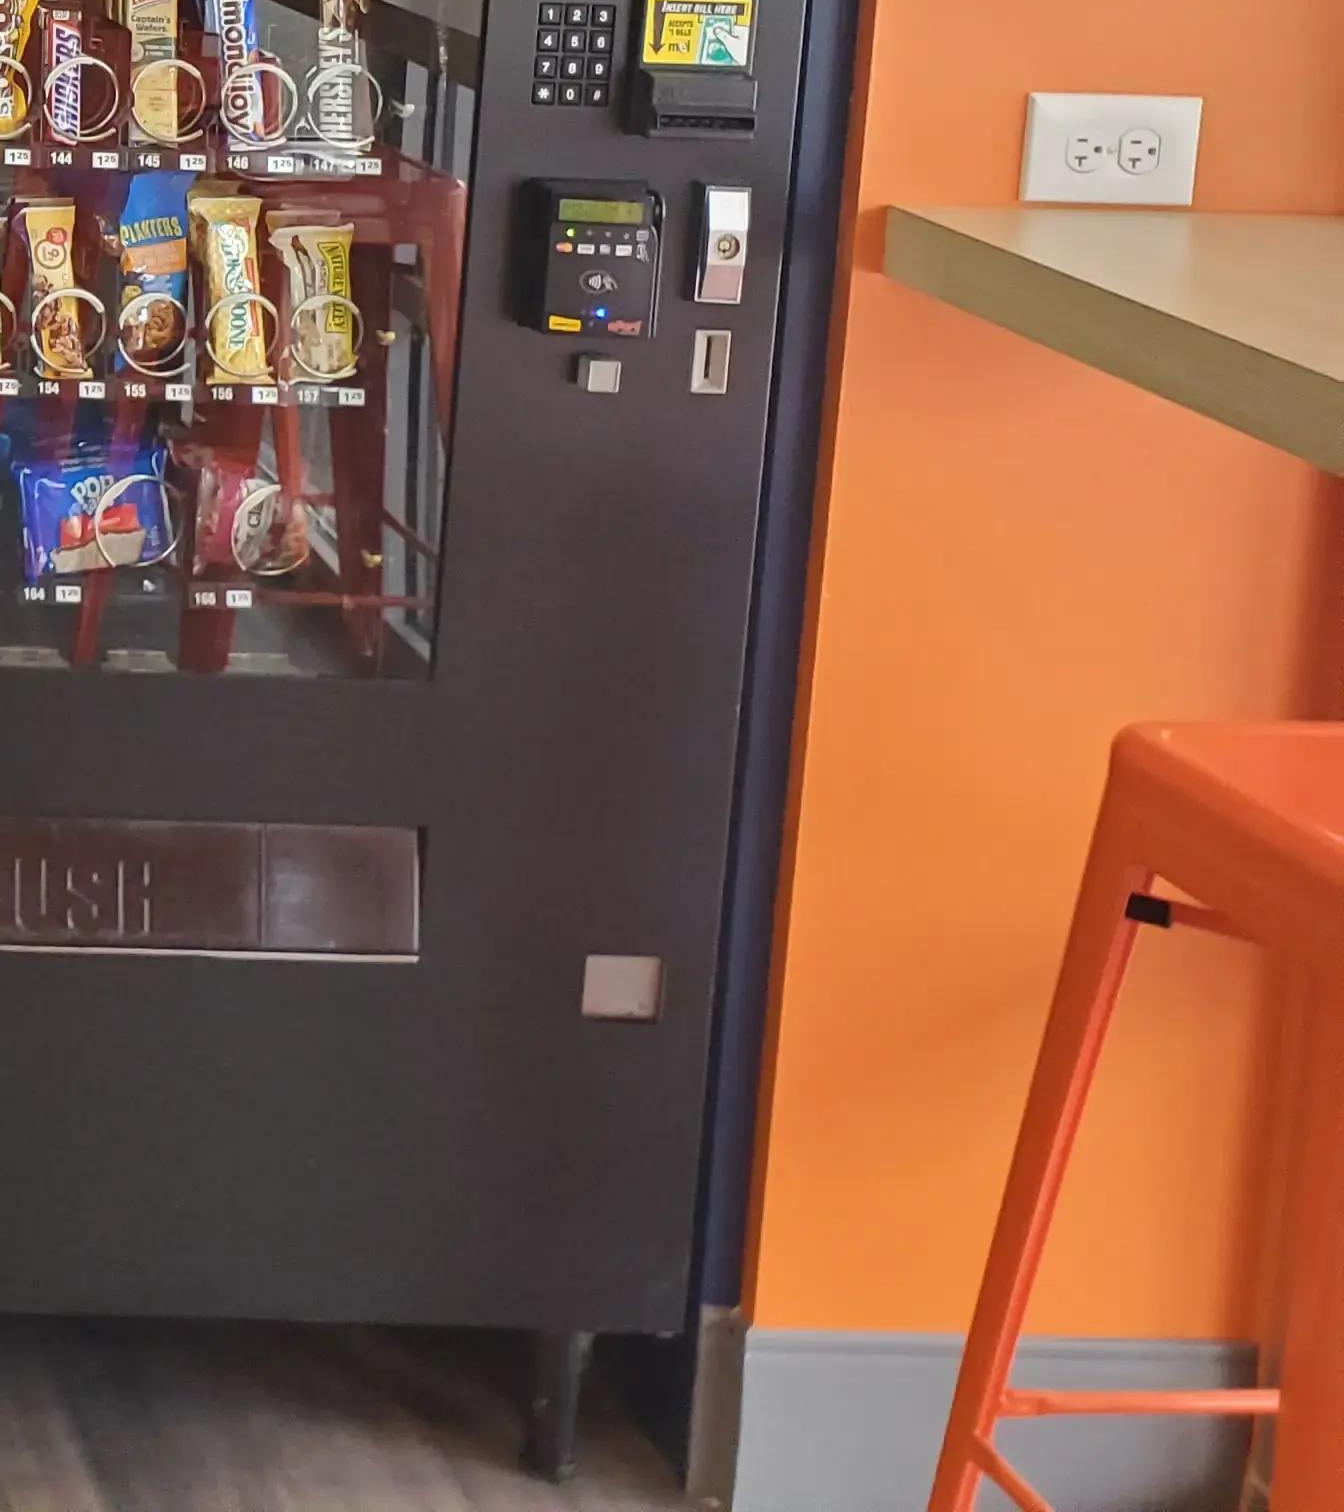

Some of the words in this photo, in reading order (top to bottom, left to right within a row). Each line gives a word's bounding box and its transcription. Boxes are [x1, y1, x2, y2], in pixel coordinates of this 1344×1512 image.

[661, 1, 692, 14] INSERT
[694, 3, 712, 14] BILL
[130, 14, 170, 26] Captain's
[547, 8, 553, 21] 1
[572, 9, 581, 21] 2
[599, 10, 608, 21] 3
[544, 35, 552, 46] 4
[571, 36, 579, 47] 5
[597, 37, 605, 48] 6
[542, 62, 551, 73] 7
[568, 63, 576, 74] 8
[595, 63, 604, 74] 9
[317, 27, 353, 140] HERSHEY'S
[566, 89, 574, 100] 0
[51, 152, 72, 164] 144
[138, 155, 160, 168] 145
[226, 157, 249, 169] 146
[119, 216, 183, 244] PLANTERS
[37, 381, 59, 394] 154
